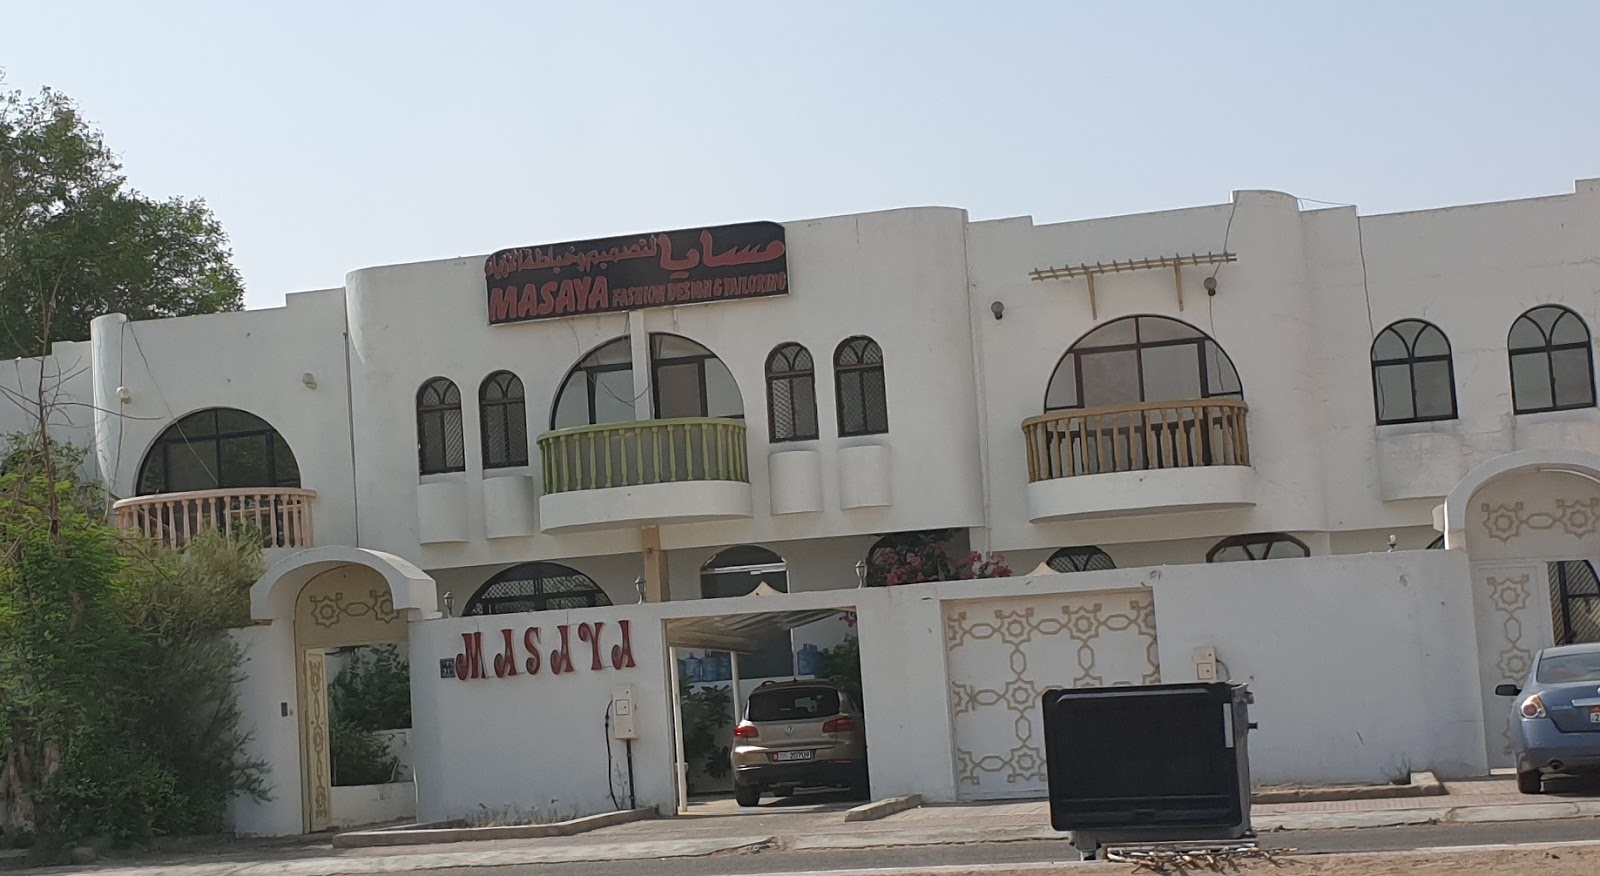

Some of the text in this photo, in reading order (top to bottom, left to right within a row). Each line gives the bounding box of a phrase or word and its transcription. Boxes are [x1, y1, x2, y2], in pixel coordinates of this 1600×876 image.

[658, 230, 786, 279] مسايا
[490, 276, 609, 321] MASAYA
[612, 285, 665, 307] FASHION
[667, 279, 712, 301] DESIGN
[722, 272, 787, 297] TAILORING
[455, 619, 637, 681] MASAYA
